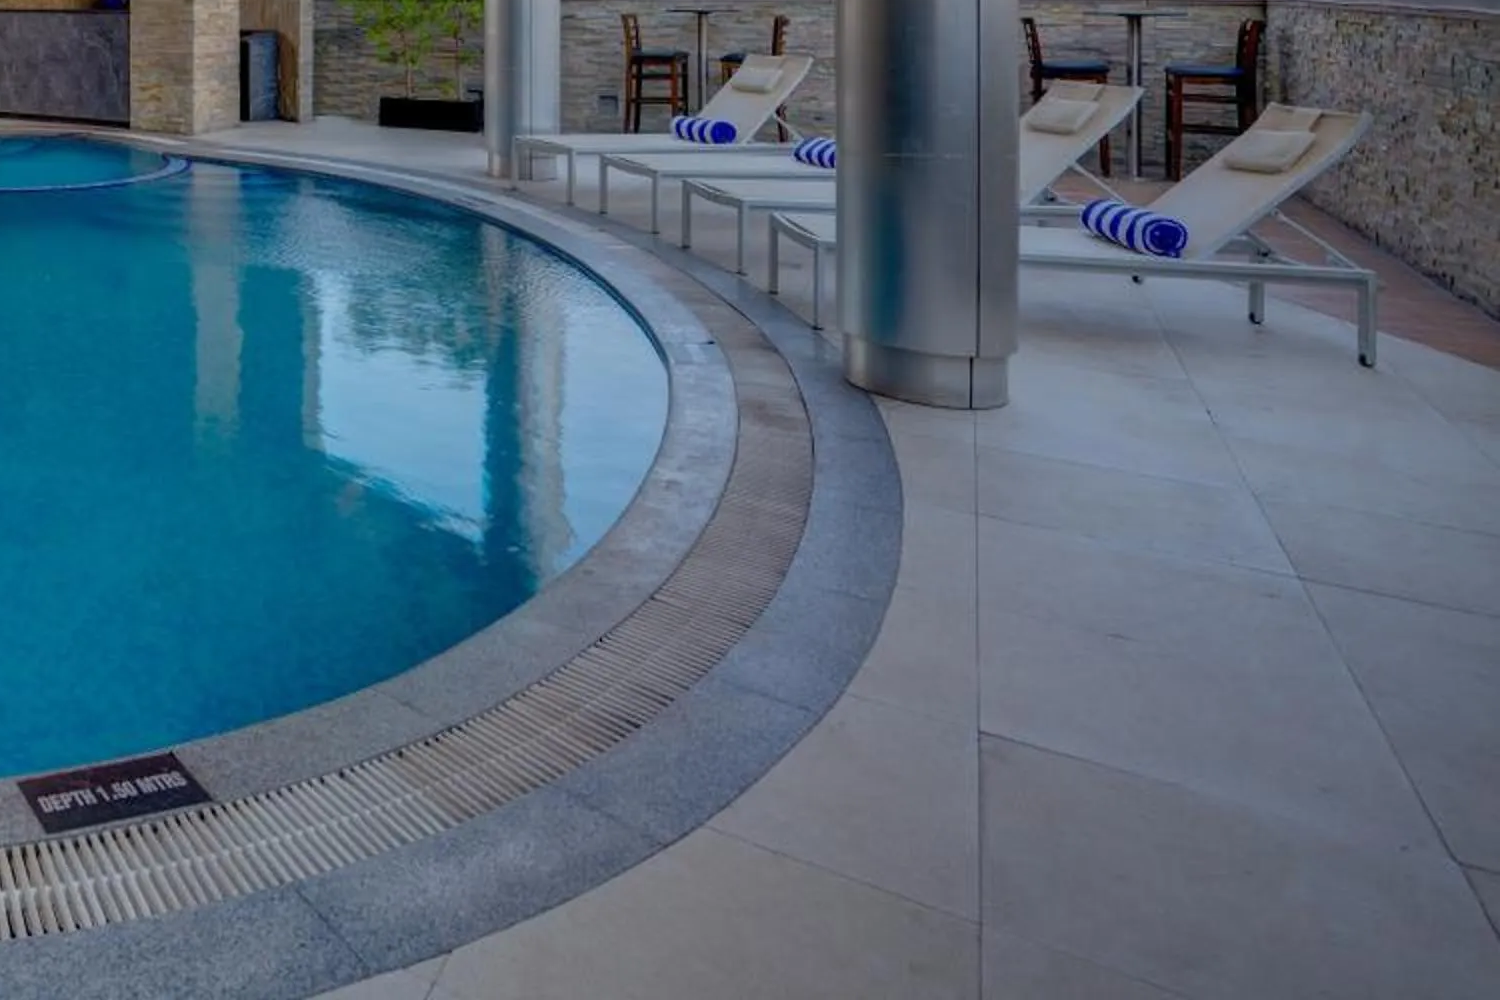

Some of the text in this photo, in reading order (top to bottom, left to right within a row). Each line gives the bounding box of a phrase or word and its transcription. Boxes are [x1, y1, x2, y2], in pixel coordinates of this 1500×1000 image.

[37, 771, 187, 813] DEPTH 1.50 MTRS
